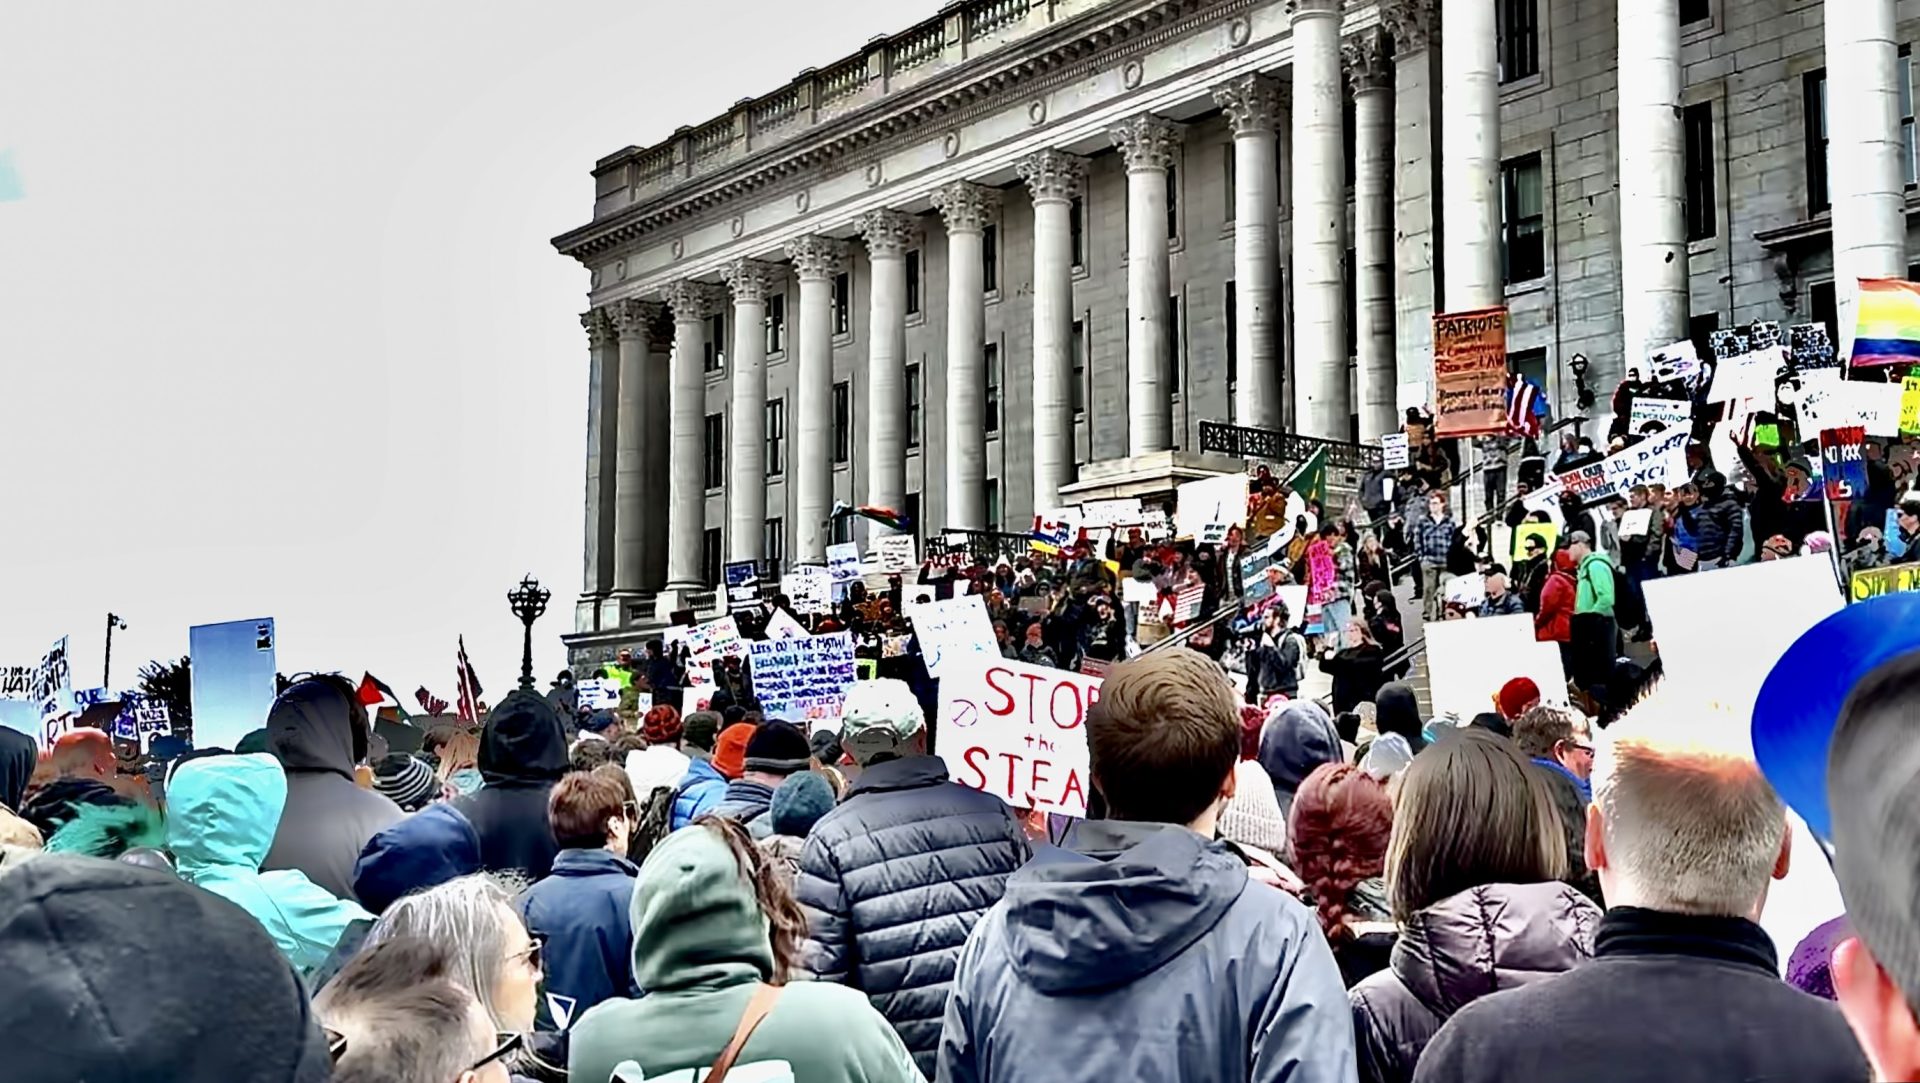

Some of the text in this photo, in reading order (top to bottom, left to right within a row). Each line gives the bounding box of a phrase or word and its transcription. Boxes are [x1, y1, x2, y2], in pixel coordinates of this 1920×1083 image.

[1437, 314, 1503, 341] PATRIOTS
[1582, 463, 1604, 478] OUR
[1024, 733, 1055, 753] the
[957, 746, 1086, 809] STEA
